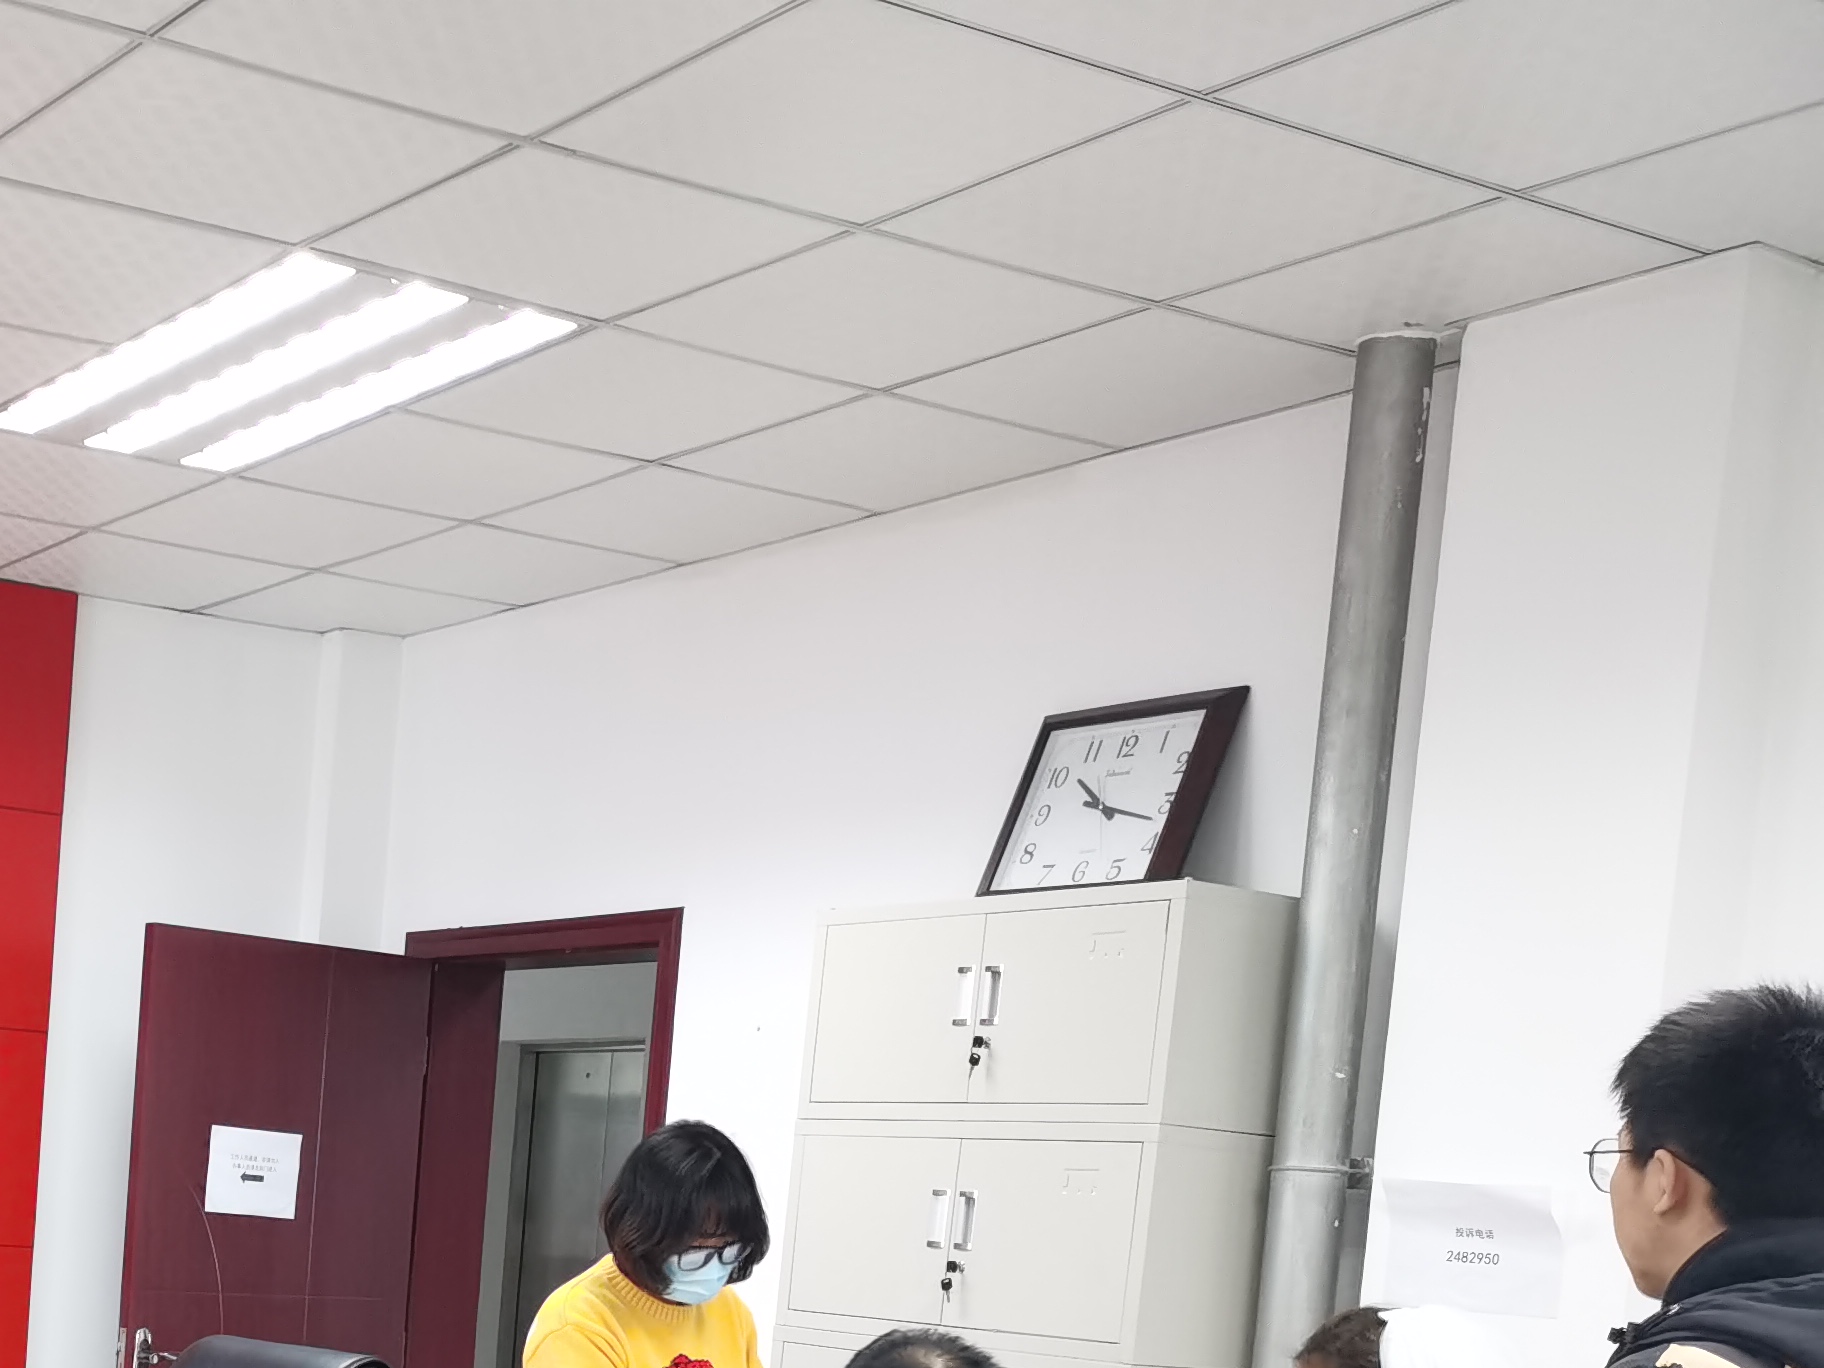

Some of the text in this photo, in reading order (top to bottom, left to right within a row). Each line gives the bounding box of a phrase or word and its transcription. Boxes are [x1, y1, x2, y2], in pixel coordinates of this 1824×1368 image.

[1084, 739, 1104, 763] 11
[1116, 734, 1140, 760] 12
[1159, 730, 1170, 753] 1
[1172, 751, 1191, 775] 2
[1047, 766, 1070, 789] 10
[1158, 792, 1176, 815] 3
[1034, 804, 1052, 826] 9
[1020, 843, 1036, 864] 8
[1140, 832, 1160, 854] 4
[1036, 864, 1056, 885] 7
[1072, 861, 1089, 883] 6
[1105, 858, 1127, 880] 5
[1455, 1227, 1495, 1240] 投诉电话
[1445, 1250, 1500, 1266] 2482950
